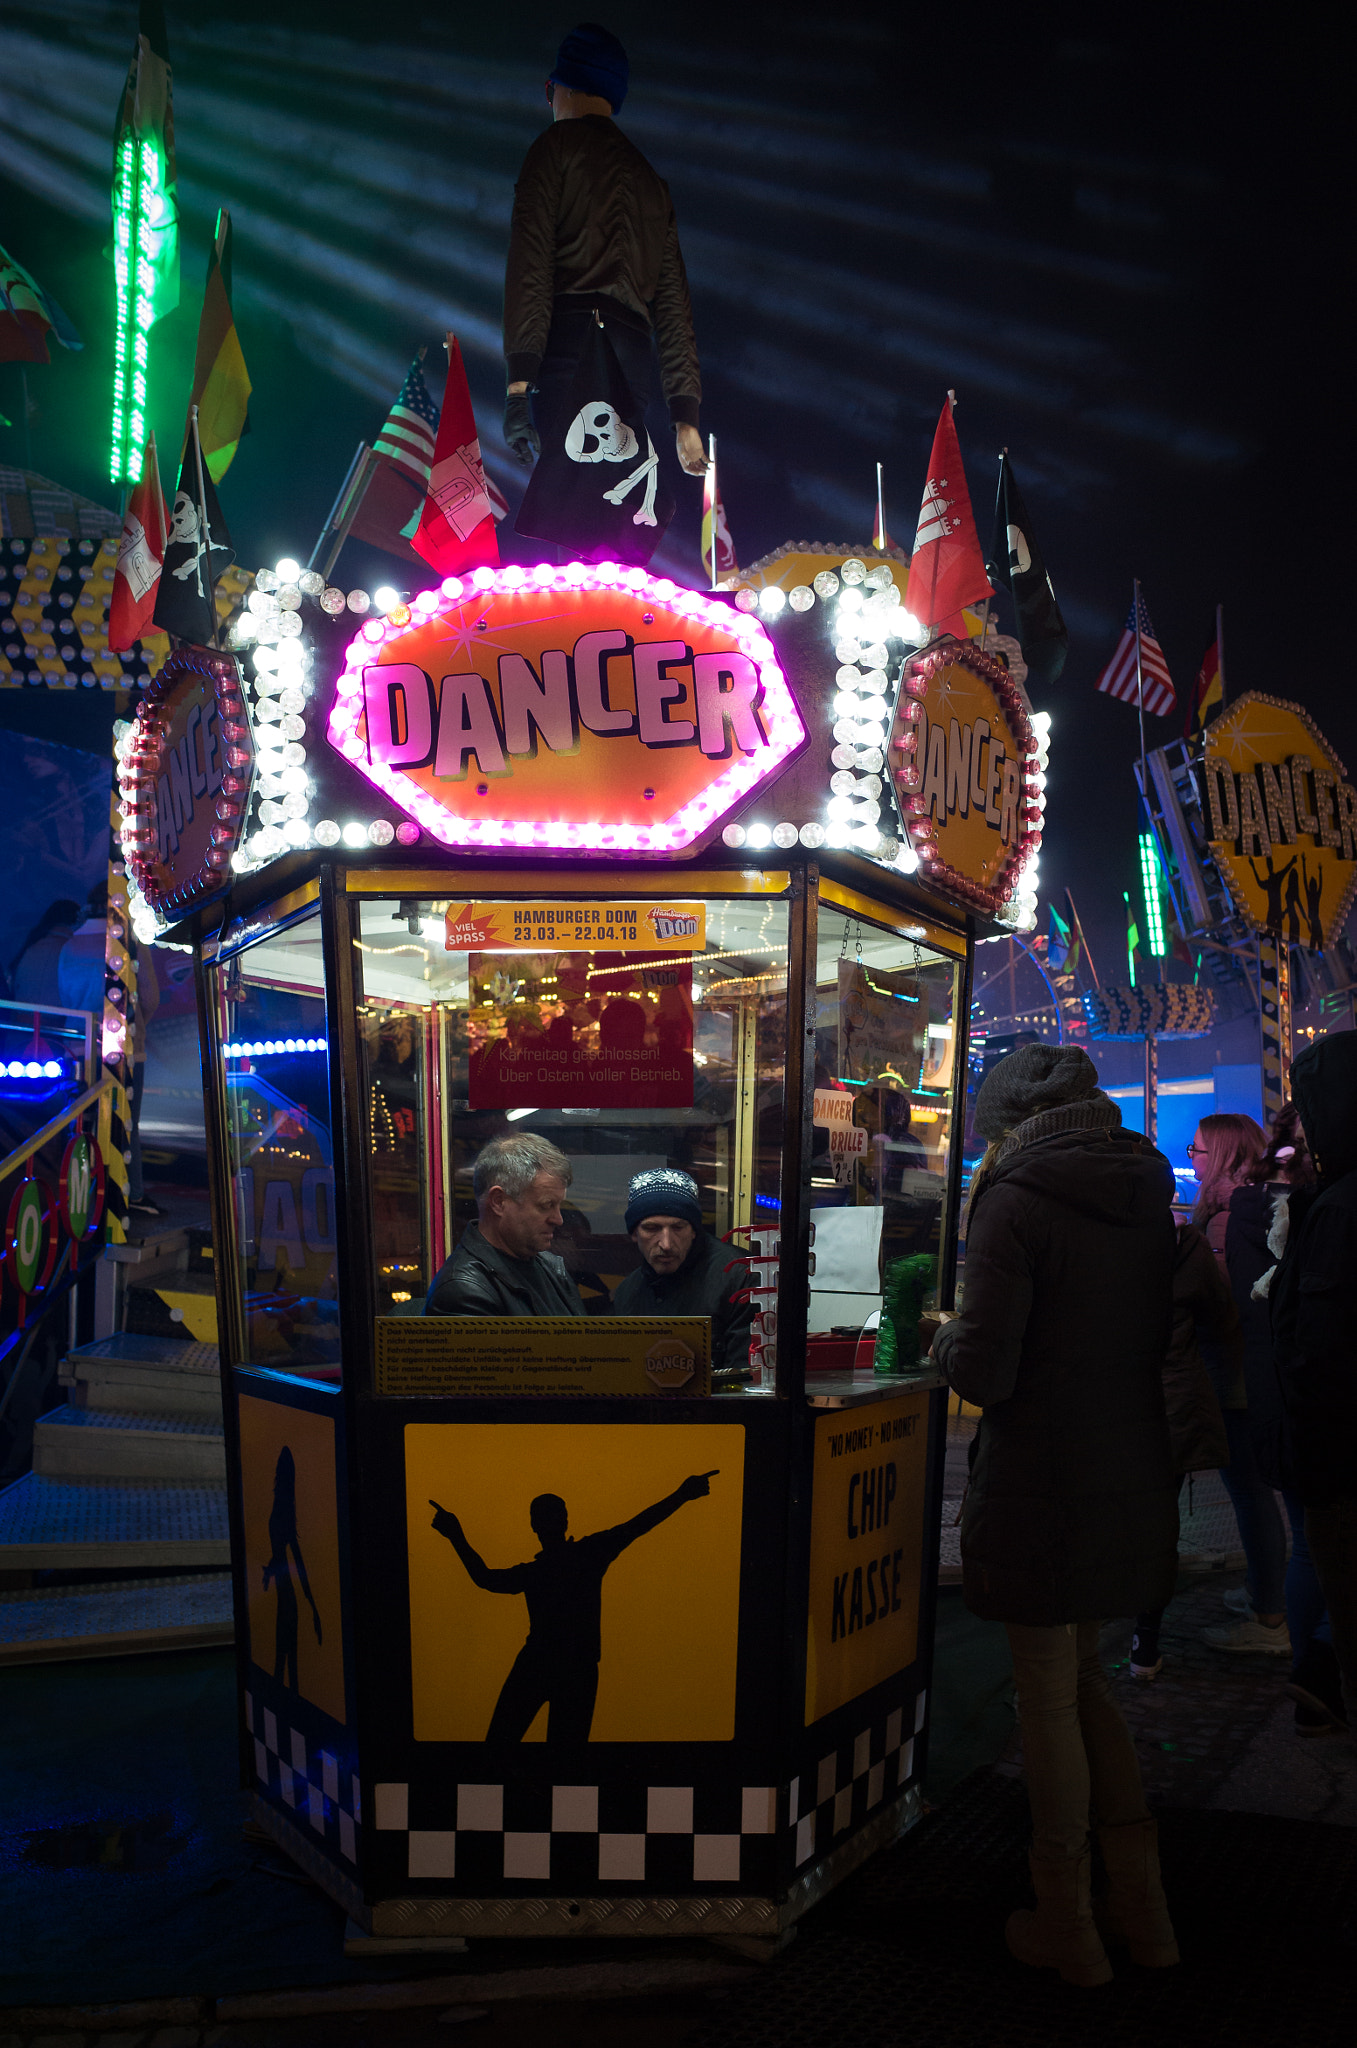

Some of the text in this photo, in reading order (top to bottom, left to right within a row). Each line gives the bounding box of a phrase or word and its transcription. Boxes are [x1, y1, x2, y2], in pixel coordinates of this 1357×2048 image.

[362, 629, 770, 780] DANCER
[902, 696, 1021, 847] DANCER
[514, 910, 637, 924] HAMBURGER DOM
[455, 923, 477, 932] VIEL
[575, 926, 637, 940] 22.04.18
[448, 931, 486, 946] SPASS
[500, 1047, 661, 1064] Karfreitag geschlossen!
[500, 1066, 684, 1082] Über Ostern voller Betrieb.
[813, 1098, 852, 1122] DANCER
[831, 1131, 864, 1152] BRILLE
[646, 1355, 695, 1373] DANCER
[880, 1421, 892, 1444] NO
[848, 1462, 897, 1540] CHIP
[832, 1549, 904, 1644] KASSE
